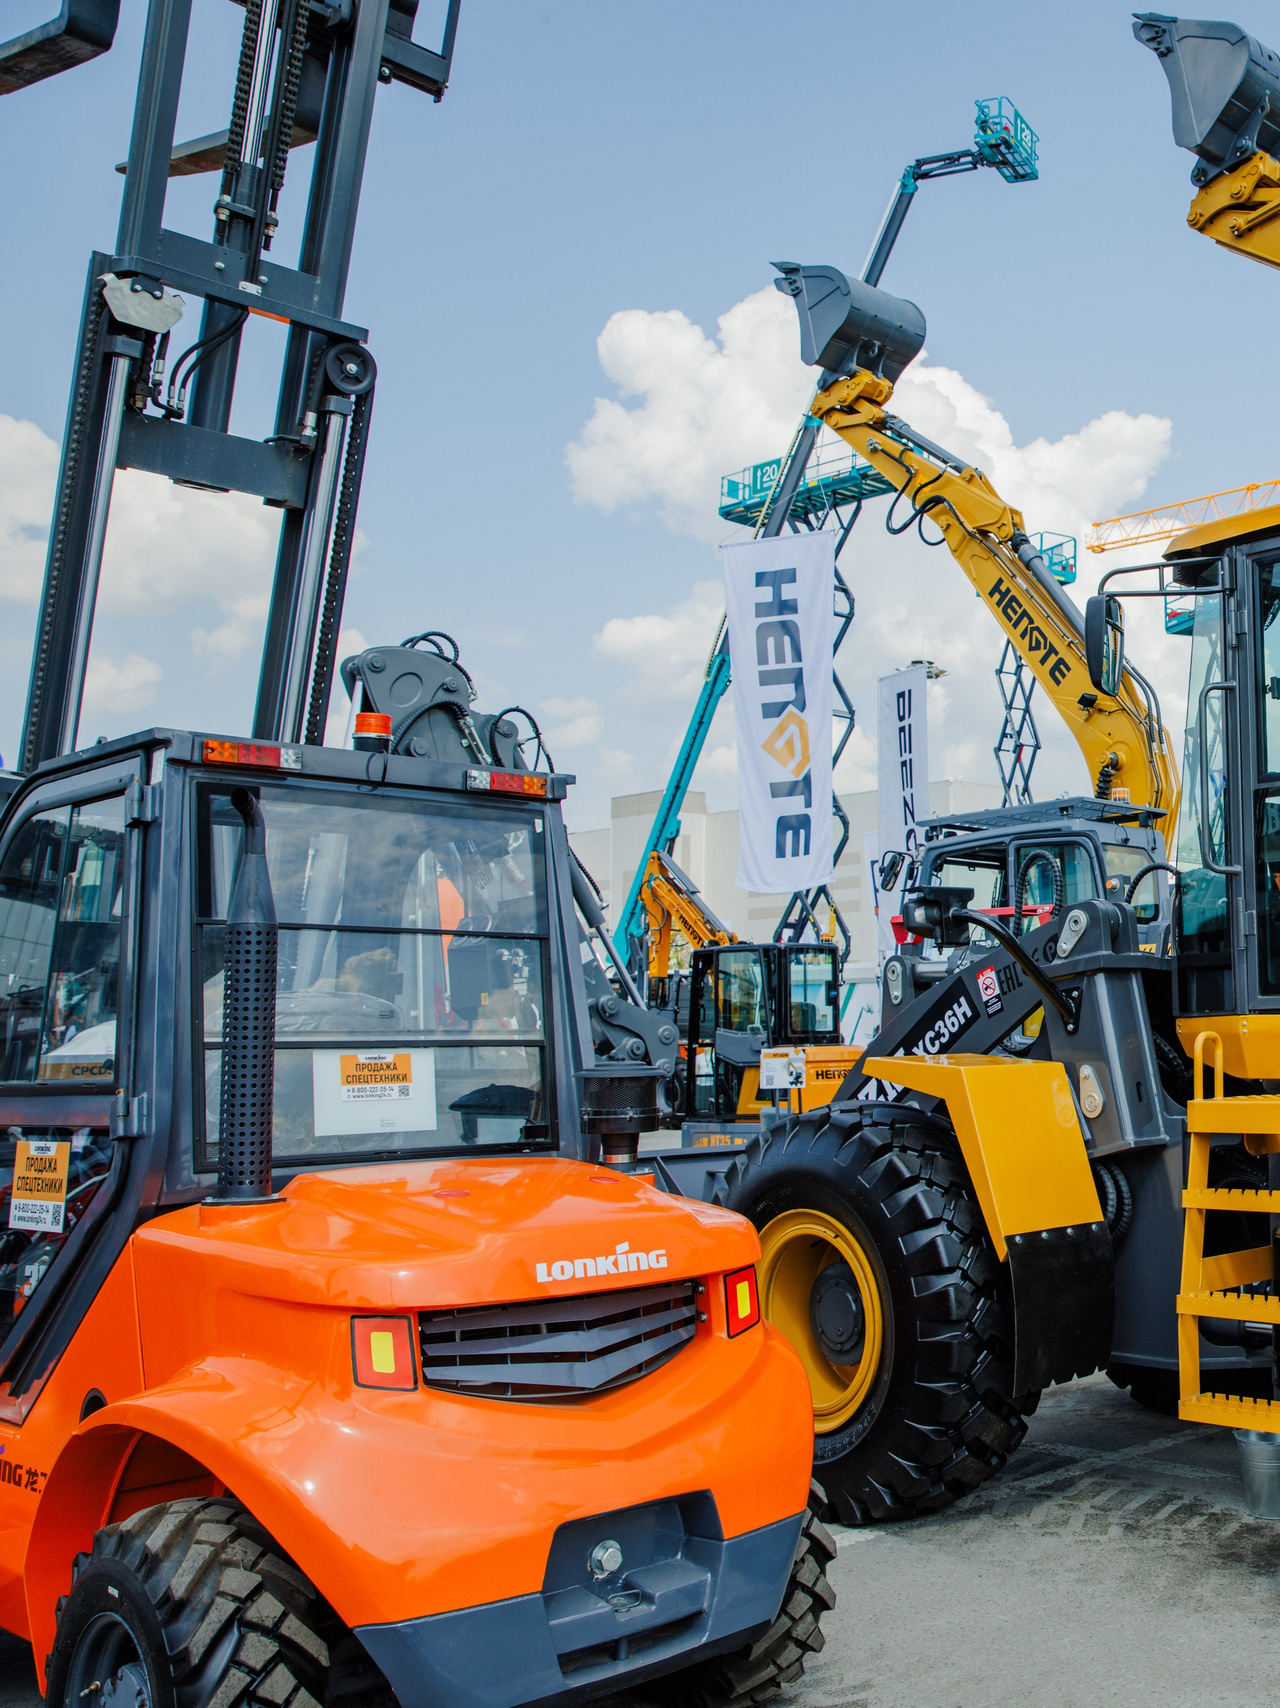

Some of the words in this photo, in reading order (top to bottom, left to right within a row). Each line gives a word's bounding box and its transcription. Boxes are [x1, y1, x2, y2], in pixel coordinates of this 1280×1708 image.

[763, 464, 778, 480] 20
[988, 577, 1072, 687] HENGTE
[754, 567, 812, 859] HENGTE
[355, 1062, 398, 1073] ПРОДАЖА
[345, 1073, 408, 1084] СПЕЦТЕХНИКИ
[351, 1086, 394, 1094] 8-800-222-05-14
[24, 1156, 58, 1175] ПРОДАЖА
[16, 1175, 64, 1195] СПЕЦТЕХНИКИ
[536, 1241, 669, 1283] LONKING
